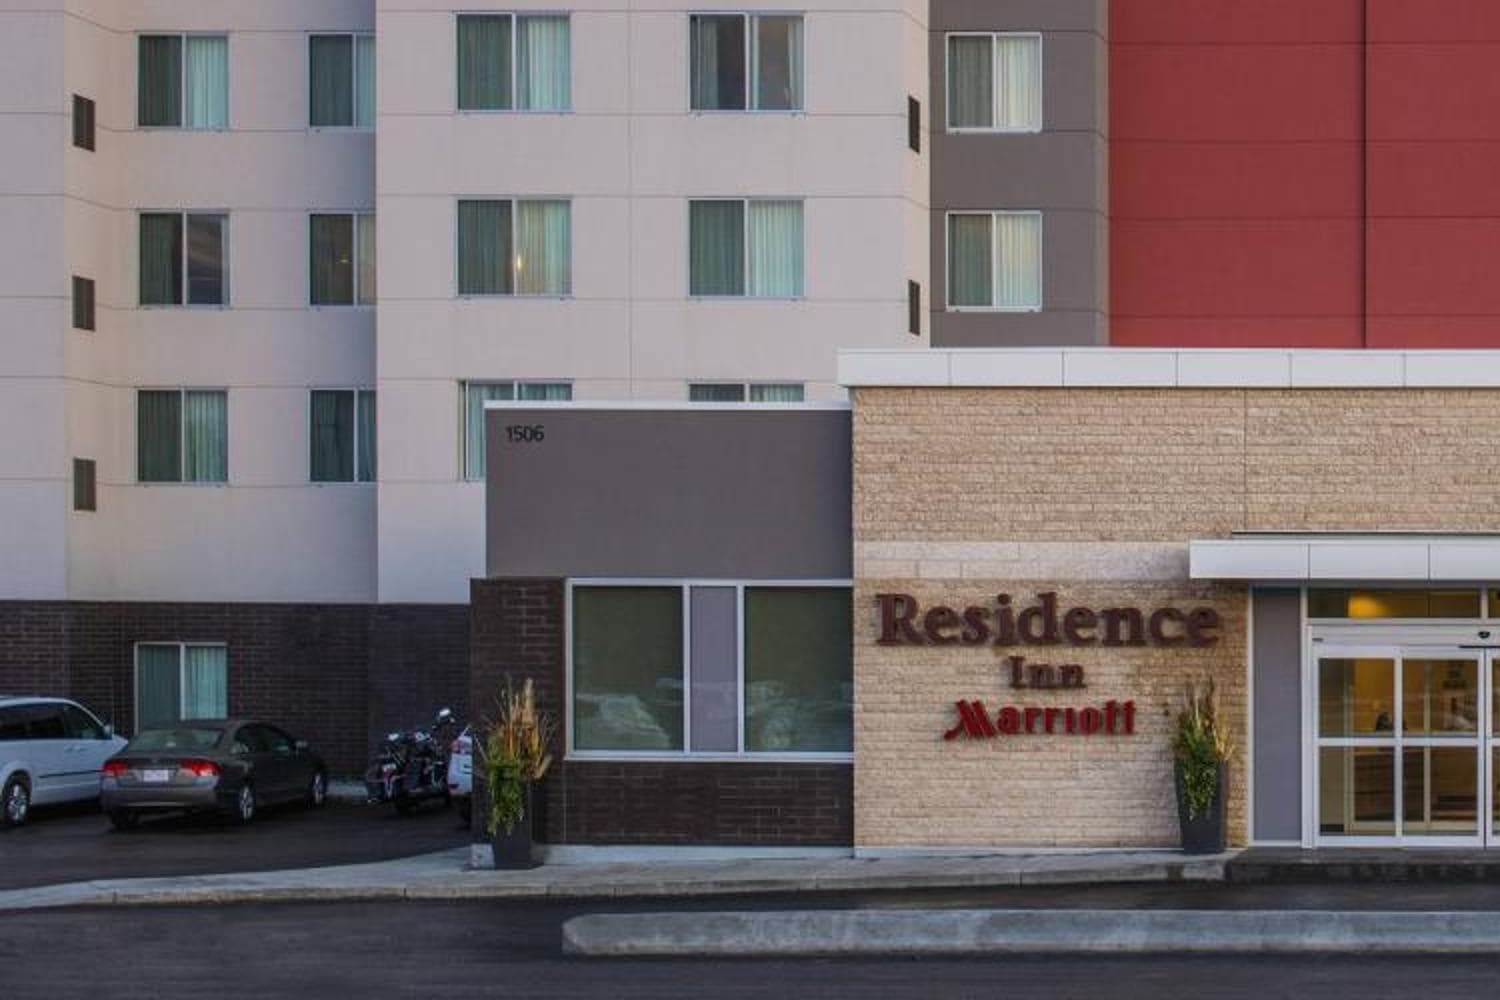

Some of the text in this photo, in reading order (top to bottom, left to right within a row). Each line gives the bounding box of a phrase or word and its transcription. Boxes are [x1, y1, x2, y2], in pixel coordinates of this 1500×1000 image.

[505, 424, 544, 442] 1506
[877, 592, 1219, 646] Residence
[1008, 656, 1087, 689] Inn
[943, 699, 1136, 740] Marriott
